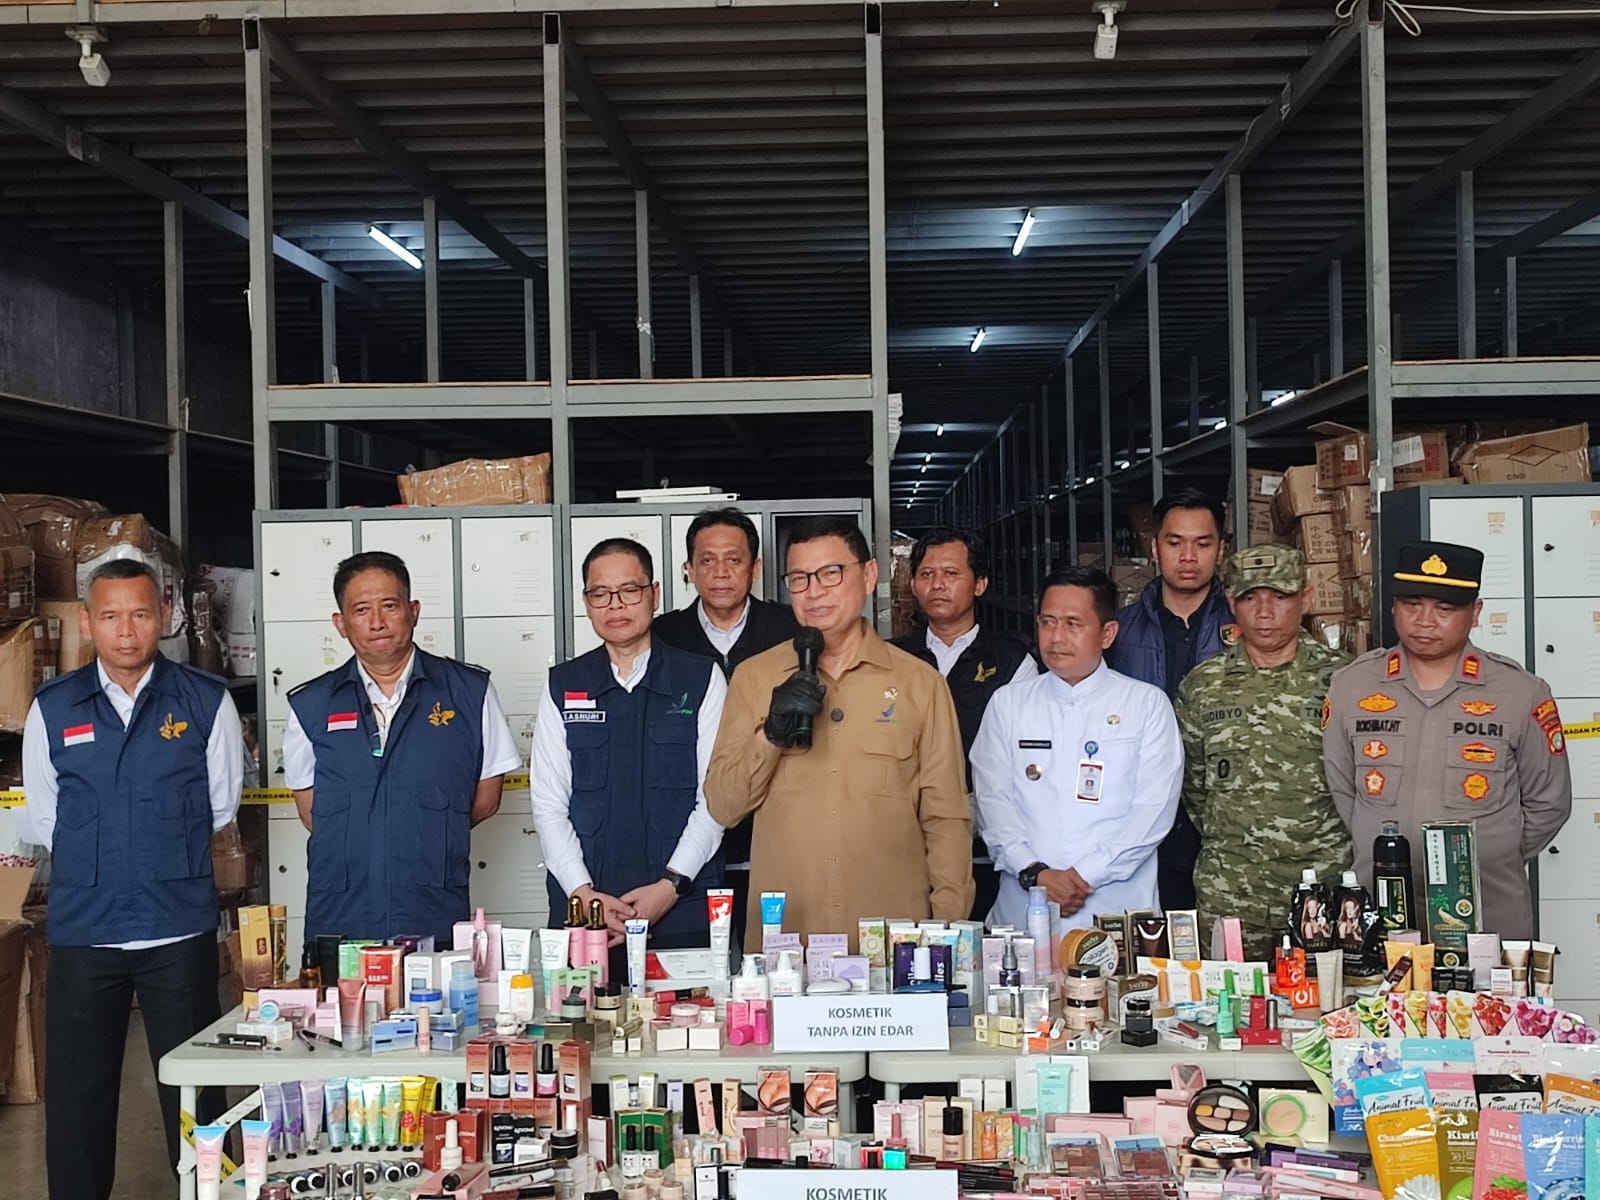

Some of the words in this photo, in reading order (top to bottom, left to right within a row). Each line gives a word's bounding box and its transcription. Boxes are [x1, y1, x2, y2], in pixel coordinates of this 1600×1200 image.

[1305, 707, 1322, 719] TN
[1453, 722, 1503, 737] POLRI
[828, 1006, 893, 1019] KOSMETIK
[807, 1026, 848, 1037] TANPA
[852, 1026, 877, 1037] IZIN
[880, 1025, 914, 1036] EDAR
[806, 1187, 888, 1200] KOSMETIK
